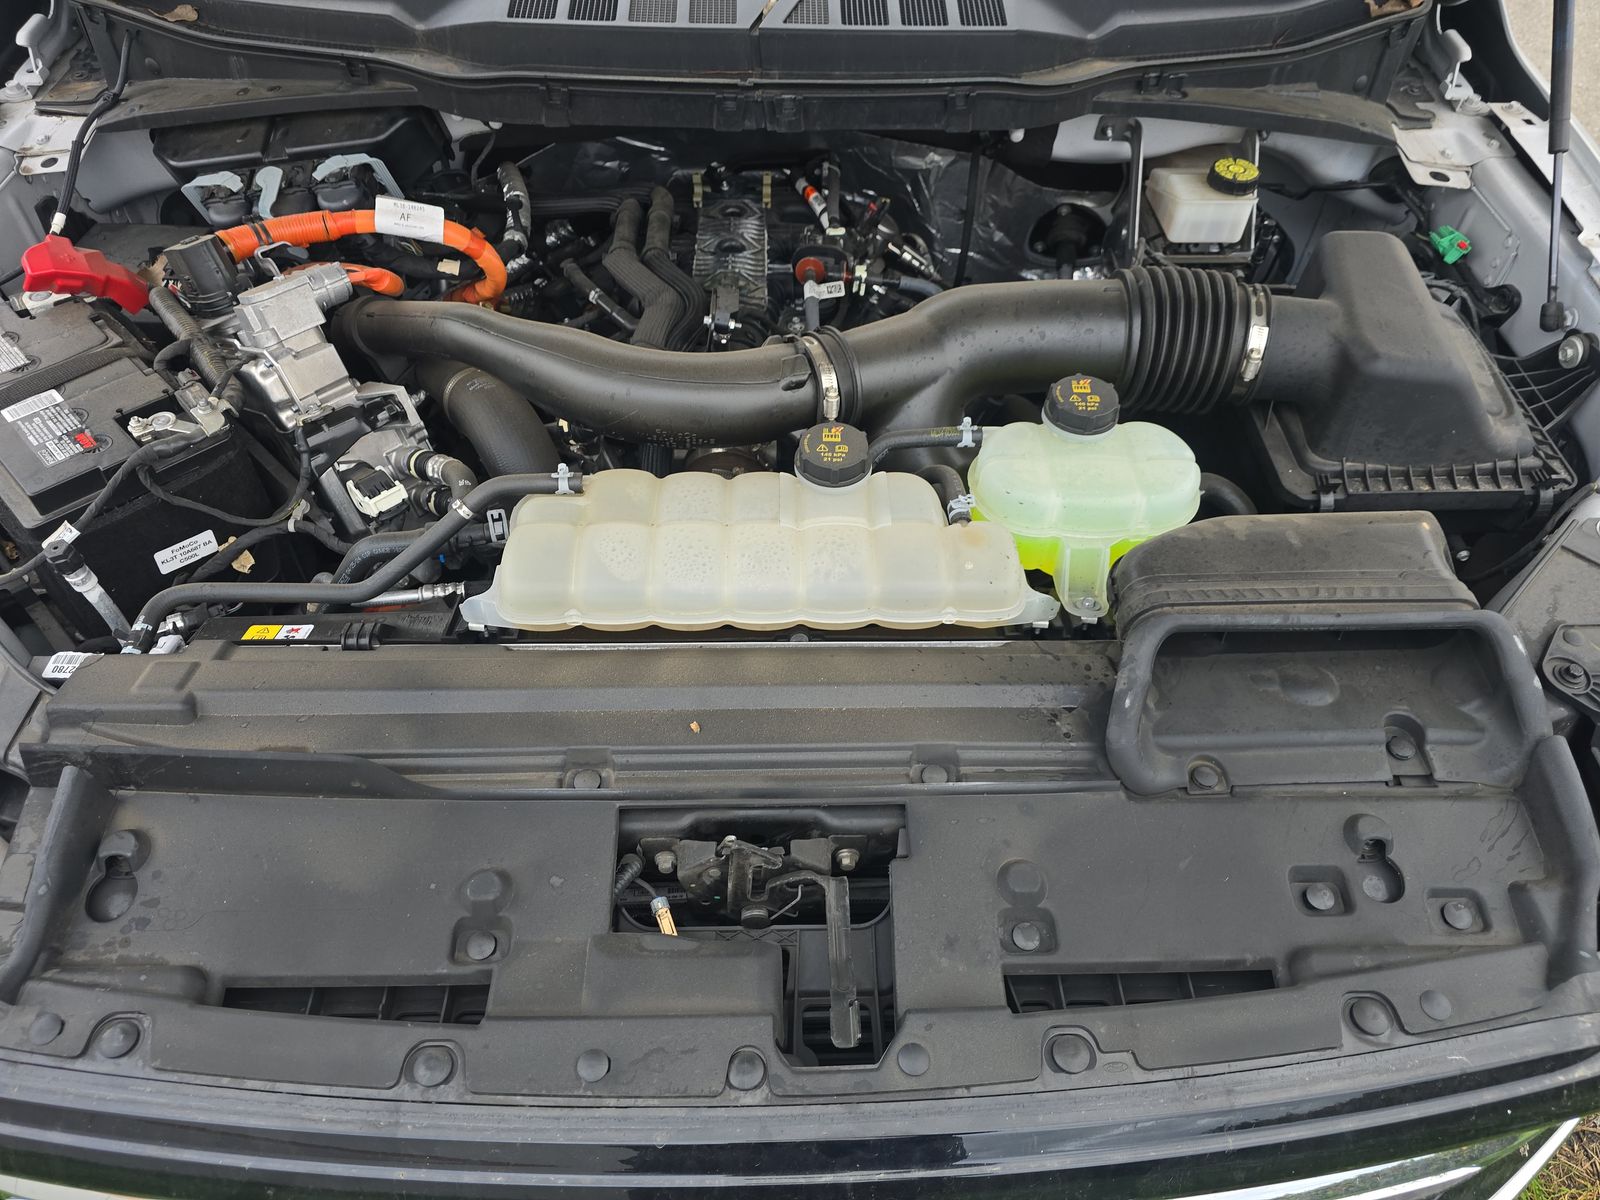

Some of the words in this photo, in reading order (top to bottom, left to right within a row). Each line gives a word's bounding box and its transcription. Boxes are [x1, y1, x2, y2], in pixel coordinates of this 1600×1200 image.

[399, 212, 412, 222] AF
[171, 540, 199, 554] FoMoCo
[161, 555, 178, 565] KL3T
[51, 665, 77, 674] 2780
